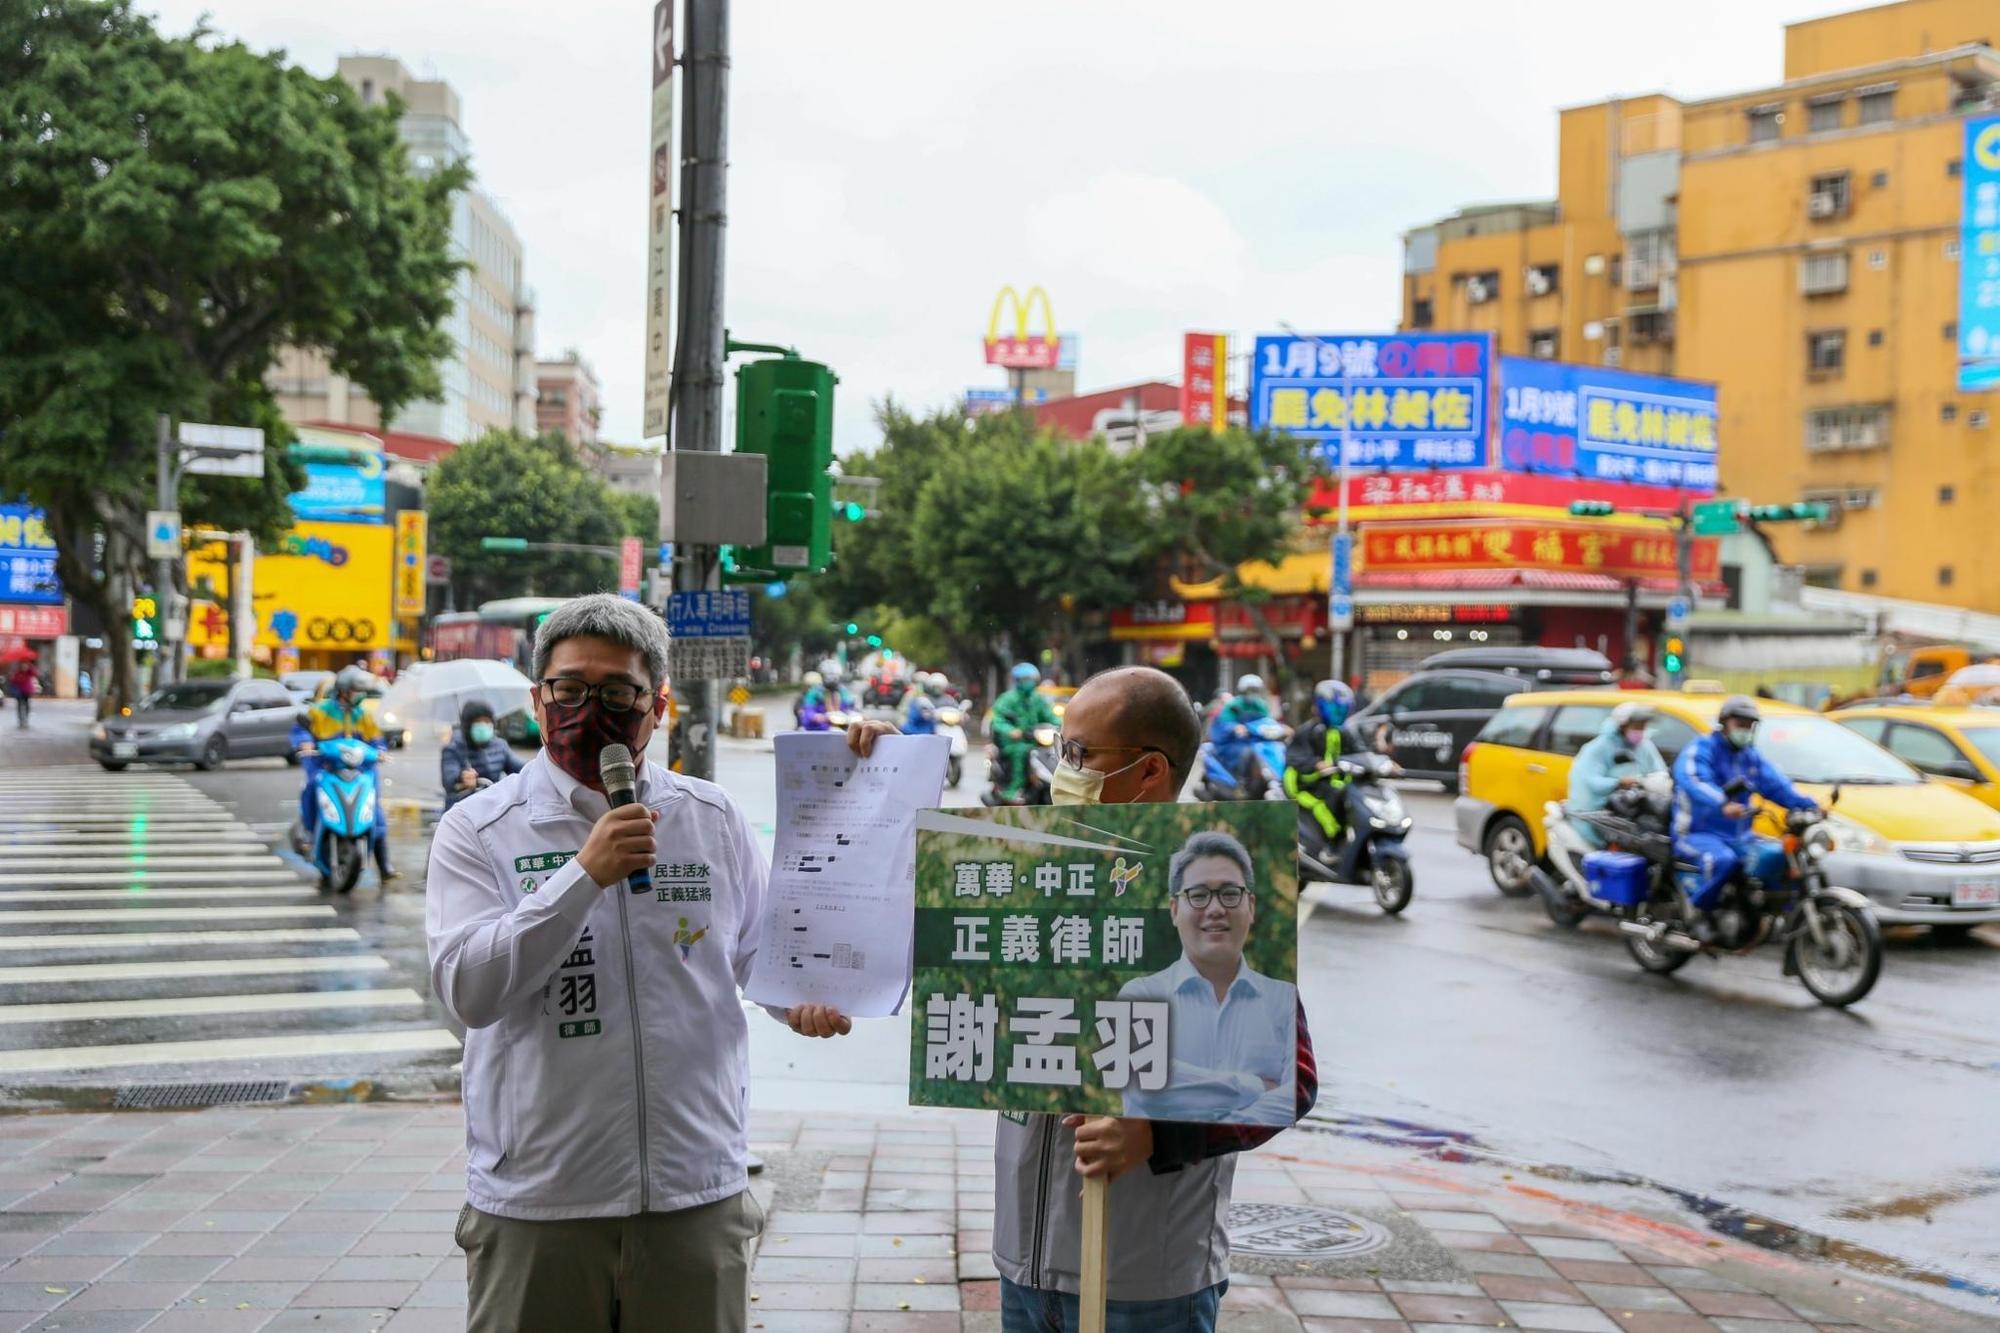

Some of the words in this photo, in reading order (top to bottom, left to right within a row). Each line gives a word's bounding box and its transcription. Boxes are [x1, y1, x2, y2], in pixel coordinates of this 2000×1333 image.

[1262, 340, 1378, 377] 1月9號
[654, 863, 711, 878] 民主活水
[955, 862, 1096, 897] 萬華·中正
[655, 886, 712, 902] 正義猛將
[951, 914, 1145, 965] 正義律師
[564, 1022, 596, 1036] 律師
[926, 992, 1170, 1091] 謝孟羽
